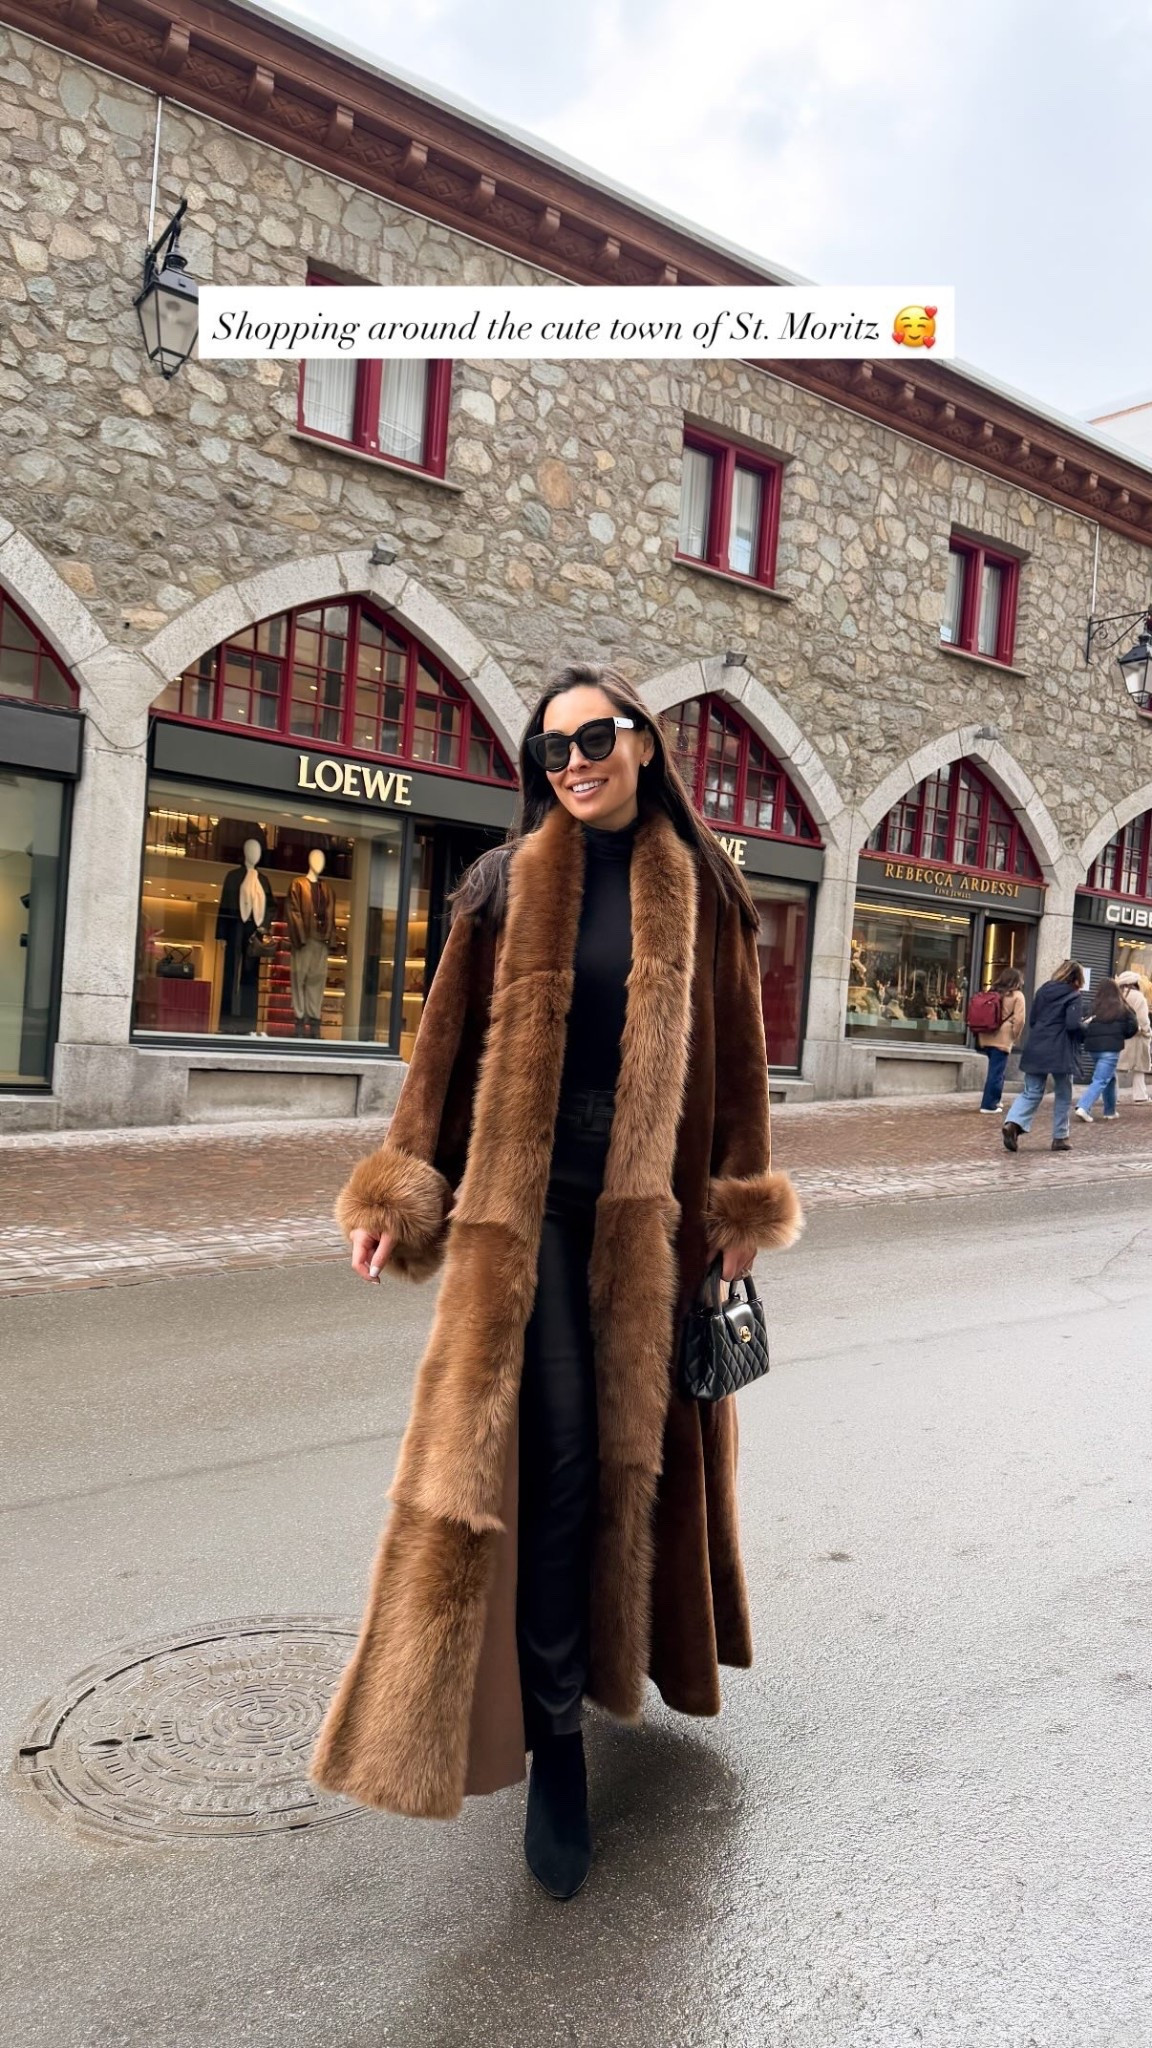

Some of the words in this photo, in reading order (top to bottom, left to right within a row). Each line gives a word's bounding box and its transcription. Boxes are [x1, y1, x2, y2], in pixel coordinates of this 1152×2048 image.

[298, 755, 413, 806] LOEWE
[885, 863, 953, 887] REBECCA
[960, 876, 1020, 898] ARDESSI
